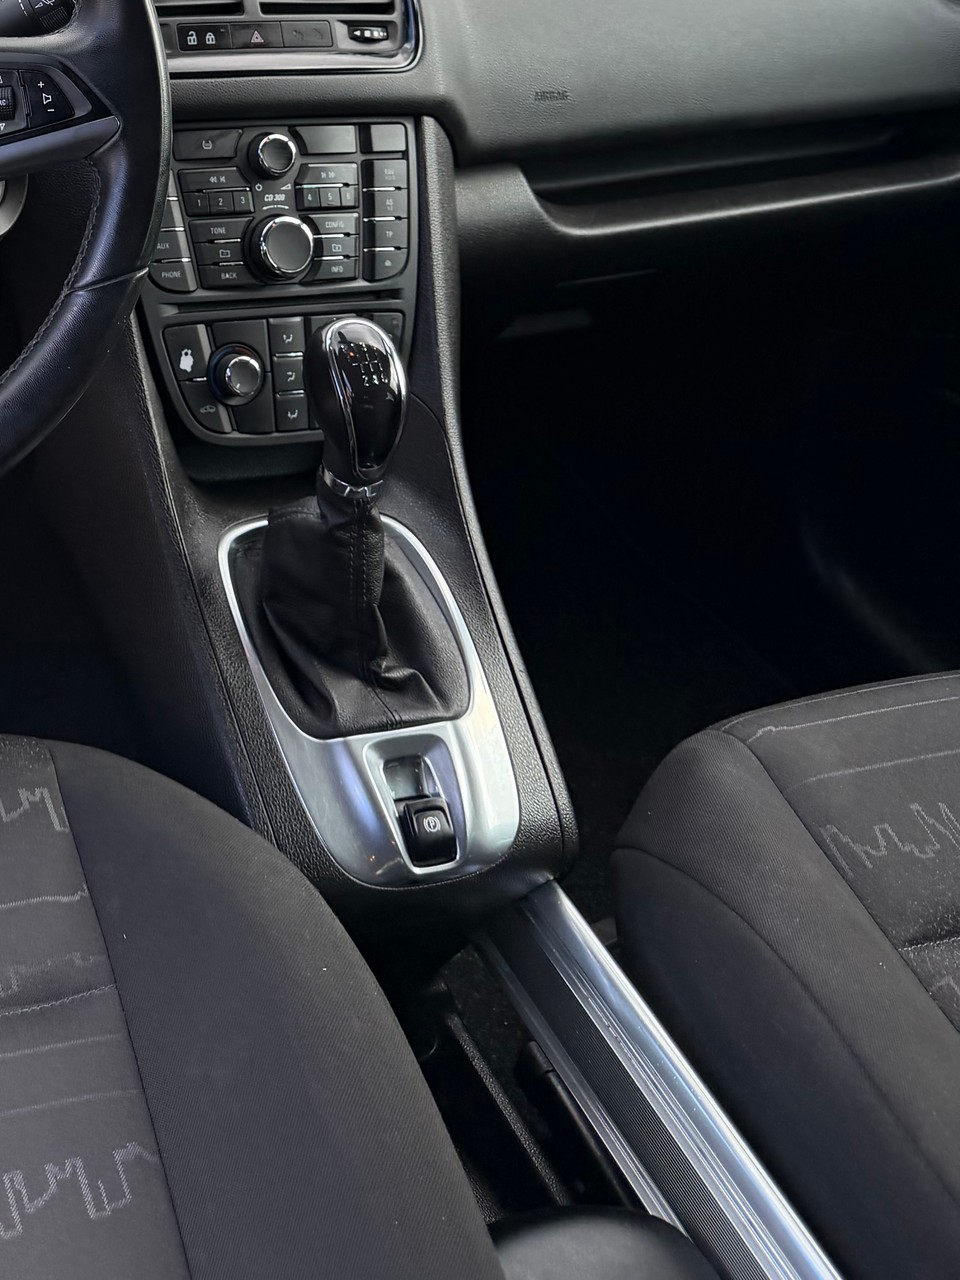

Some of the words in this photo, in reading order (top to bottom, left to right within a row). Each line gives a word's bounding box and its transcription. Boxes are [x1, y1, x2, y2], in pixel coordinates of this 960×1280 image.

[325, 221, 345, 229] CONFIG
[210, 227, 227, 235] TONE
[161, 271, 181, 279] PHONE
